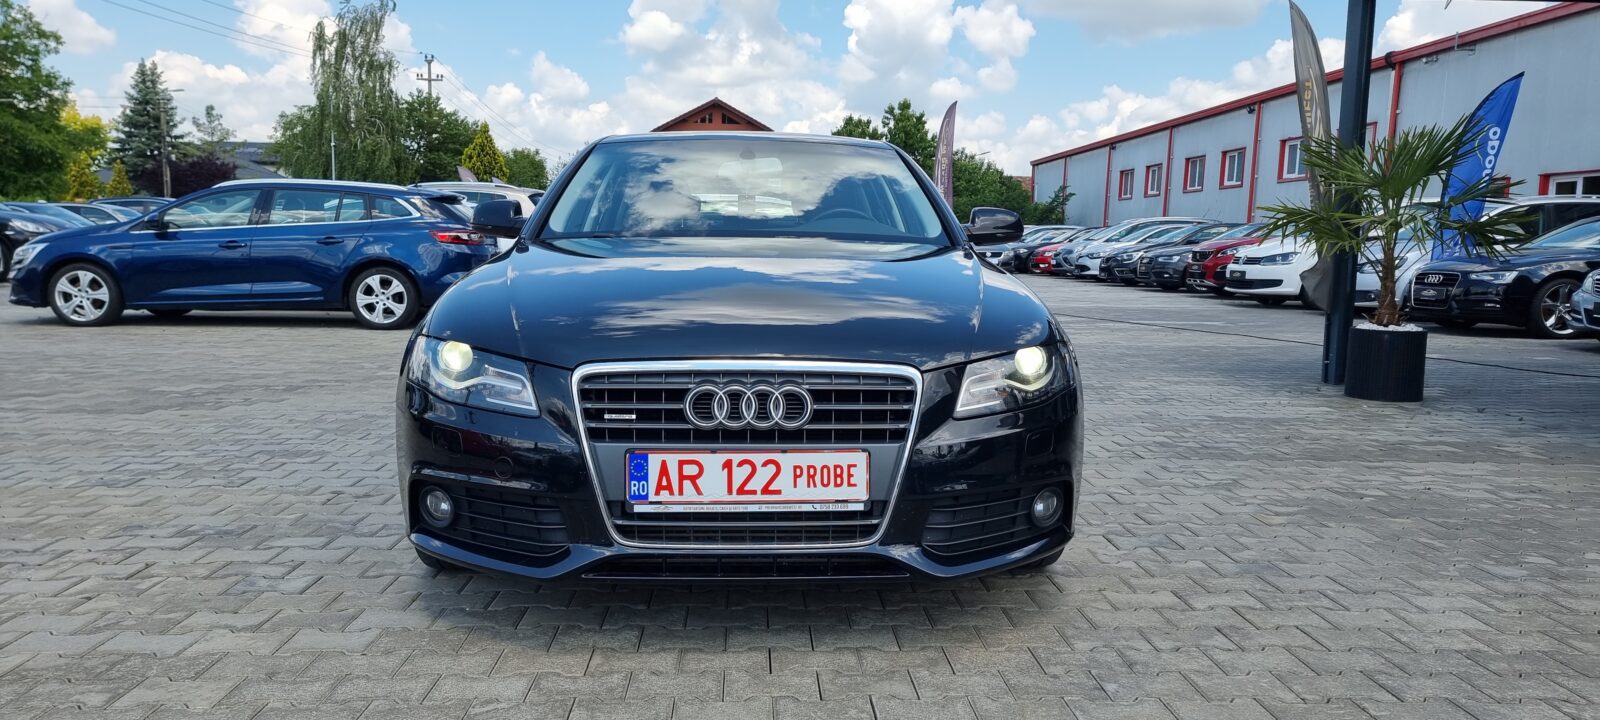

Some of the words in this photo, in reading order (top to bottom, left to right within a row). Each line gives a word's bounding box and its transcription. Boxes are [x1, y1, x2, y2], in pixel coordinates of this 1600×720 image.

[631, 481, 647, 495] RO
[654, 459, 704, 496] AR
[722, 459, 782, 495] 122
[793, 464, 857, 488] PROBE
